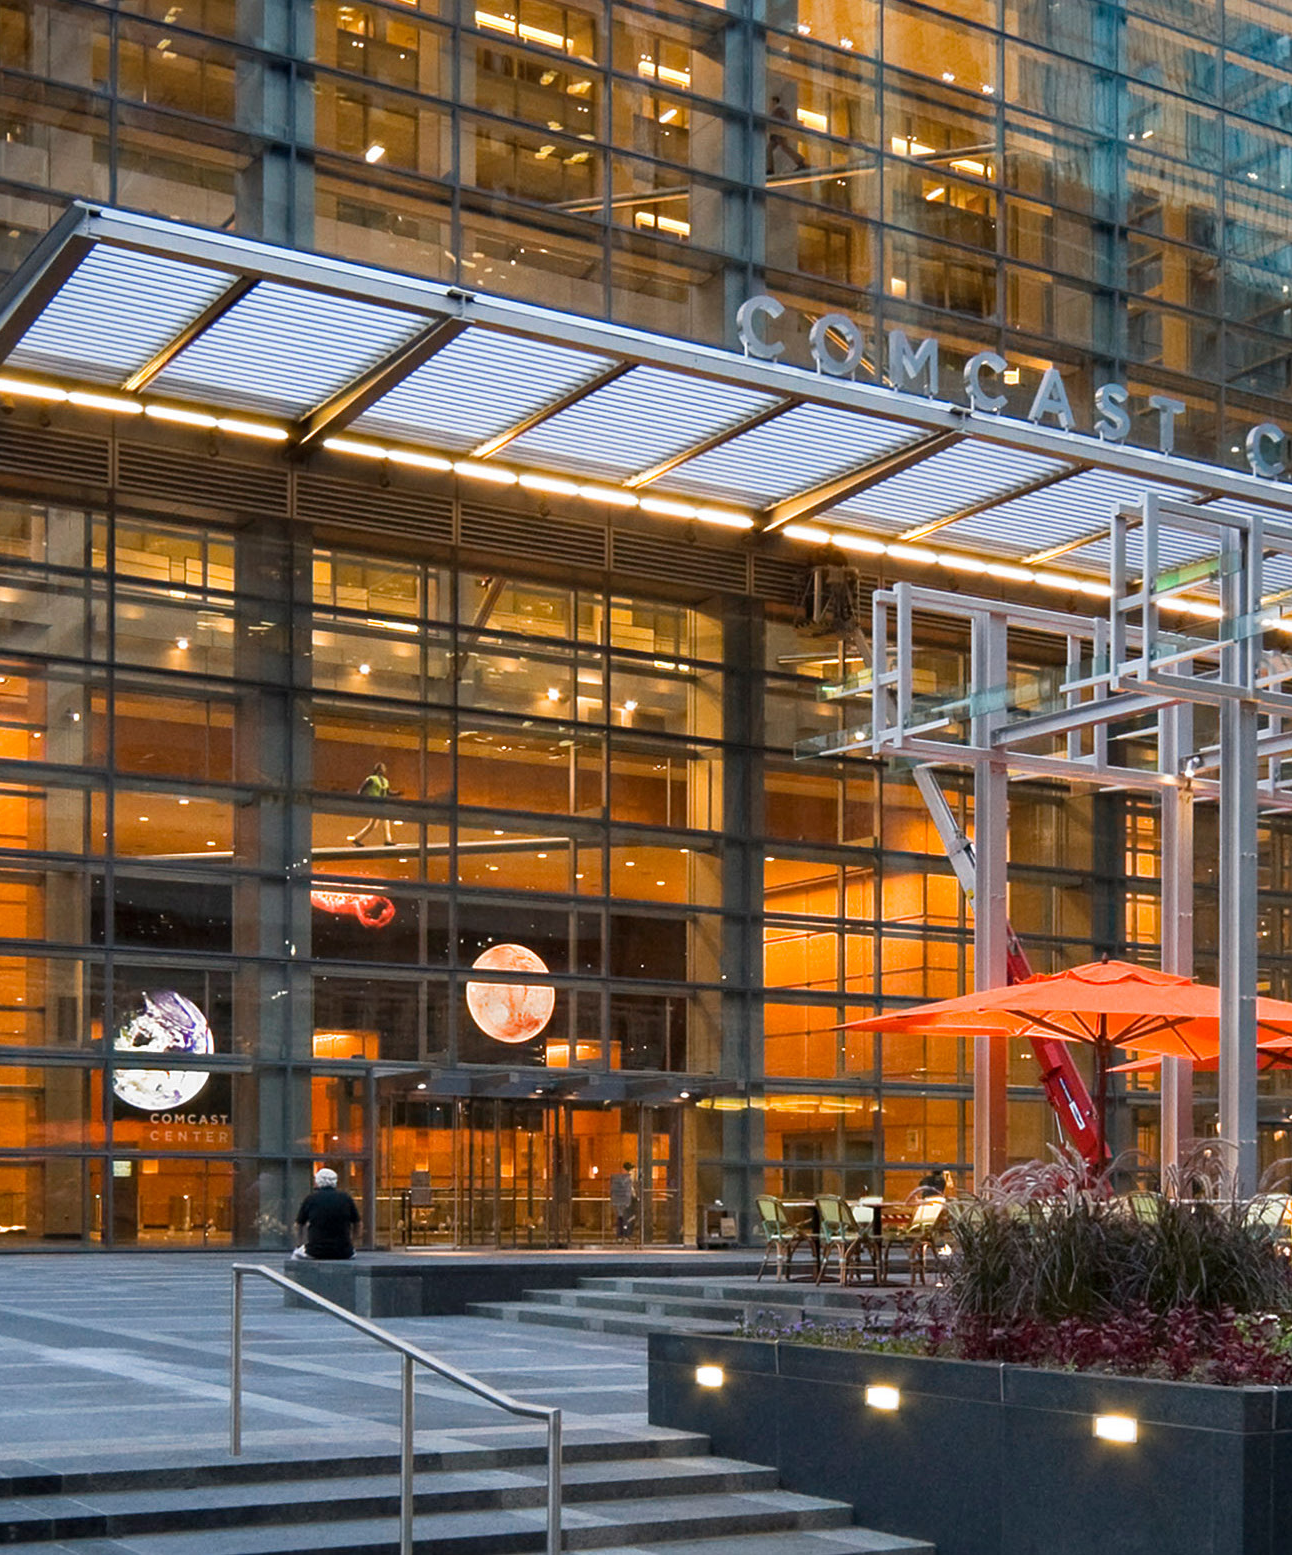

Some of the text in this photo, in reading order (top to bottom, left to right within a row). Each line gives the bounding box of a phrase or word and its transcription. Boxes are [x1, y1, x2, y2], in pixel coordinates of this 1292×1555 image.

[736, 295, 1186, 454] COMCAST
[150, 1113, 228, 1125] COMCAST
[150, 1130, 228, 1143] CENTER
